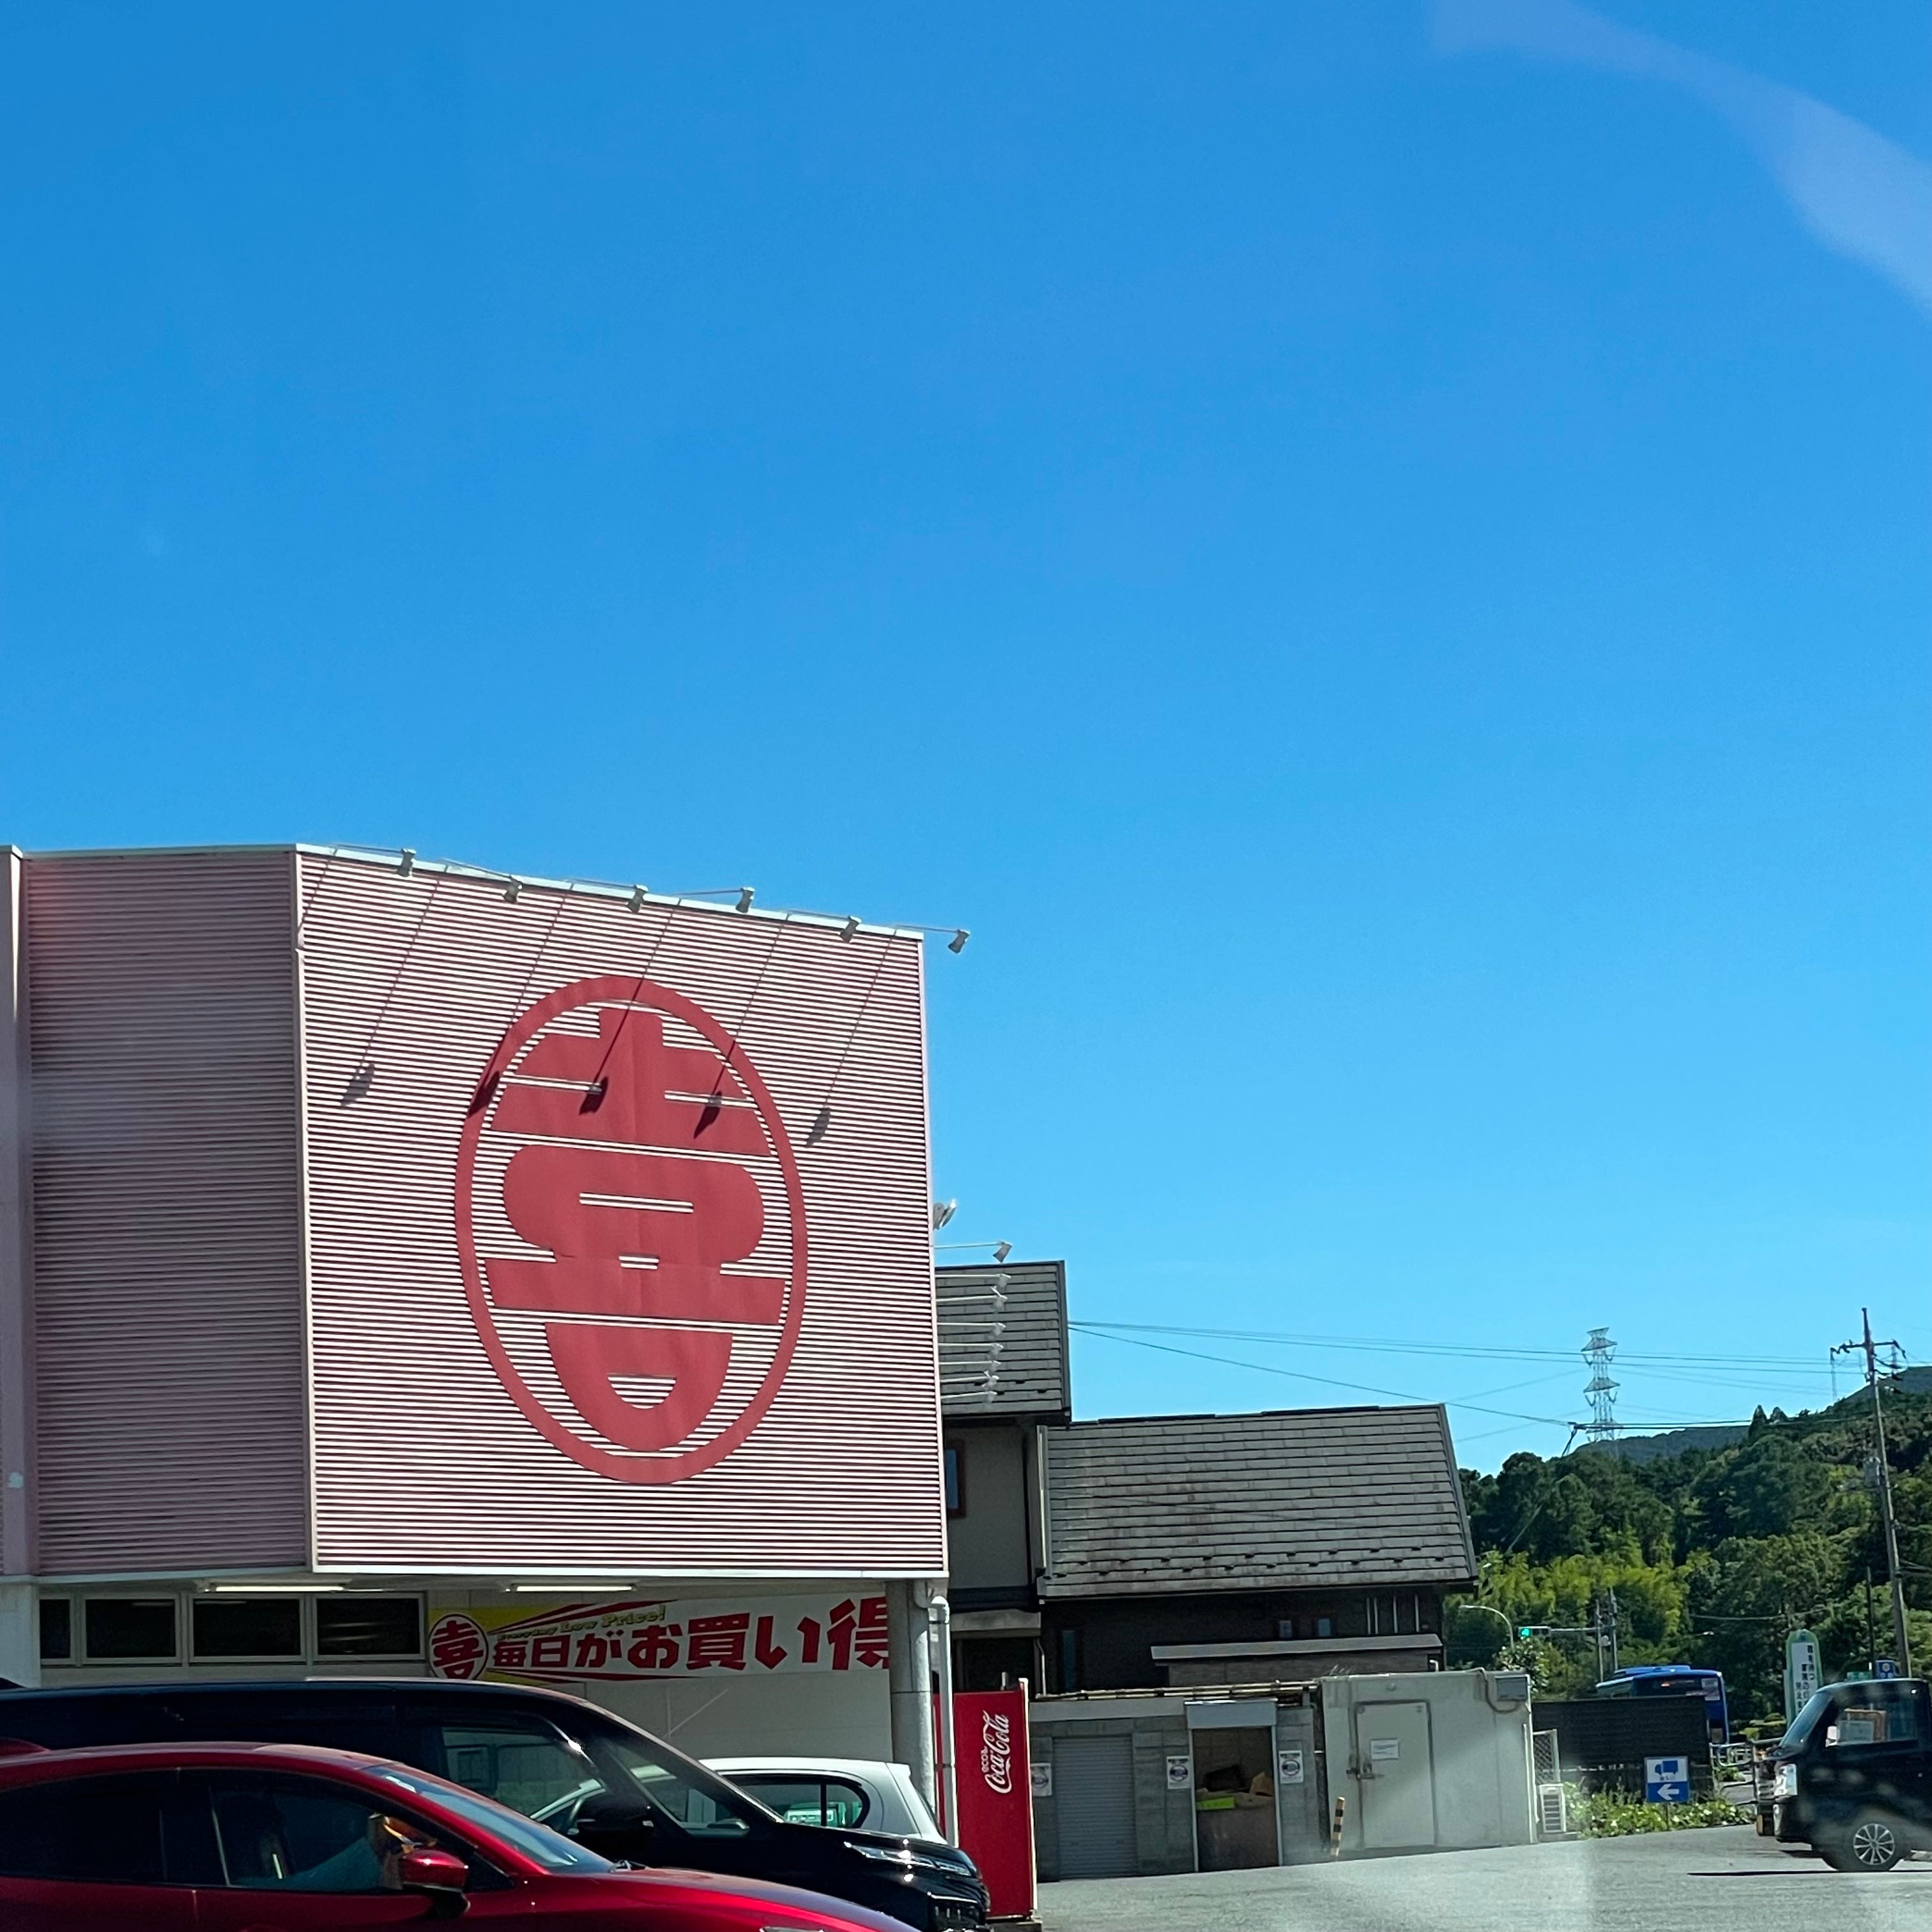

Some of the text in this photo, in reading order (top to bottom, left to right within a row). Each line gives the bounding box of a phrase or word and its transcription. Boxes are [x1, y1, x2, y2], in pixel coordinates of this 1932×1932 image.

[560, 1621, 597, 1635] Low
[601, 1604, 666, 1627] Price!
[982, 1709, 1012, 1793] Coca-Cola
